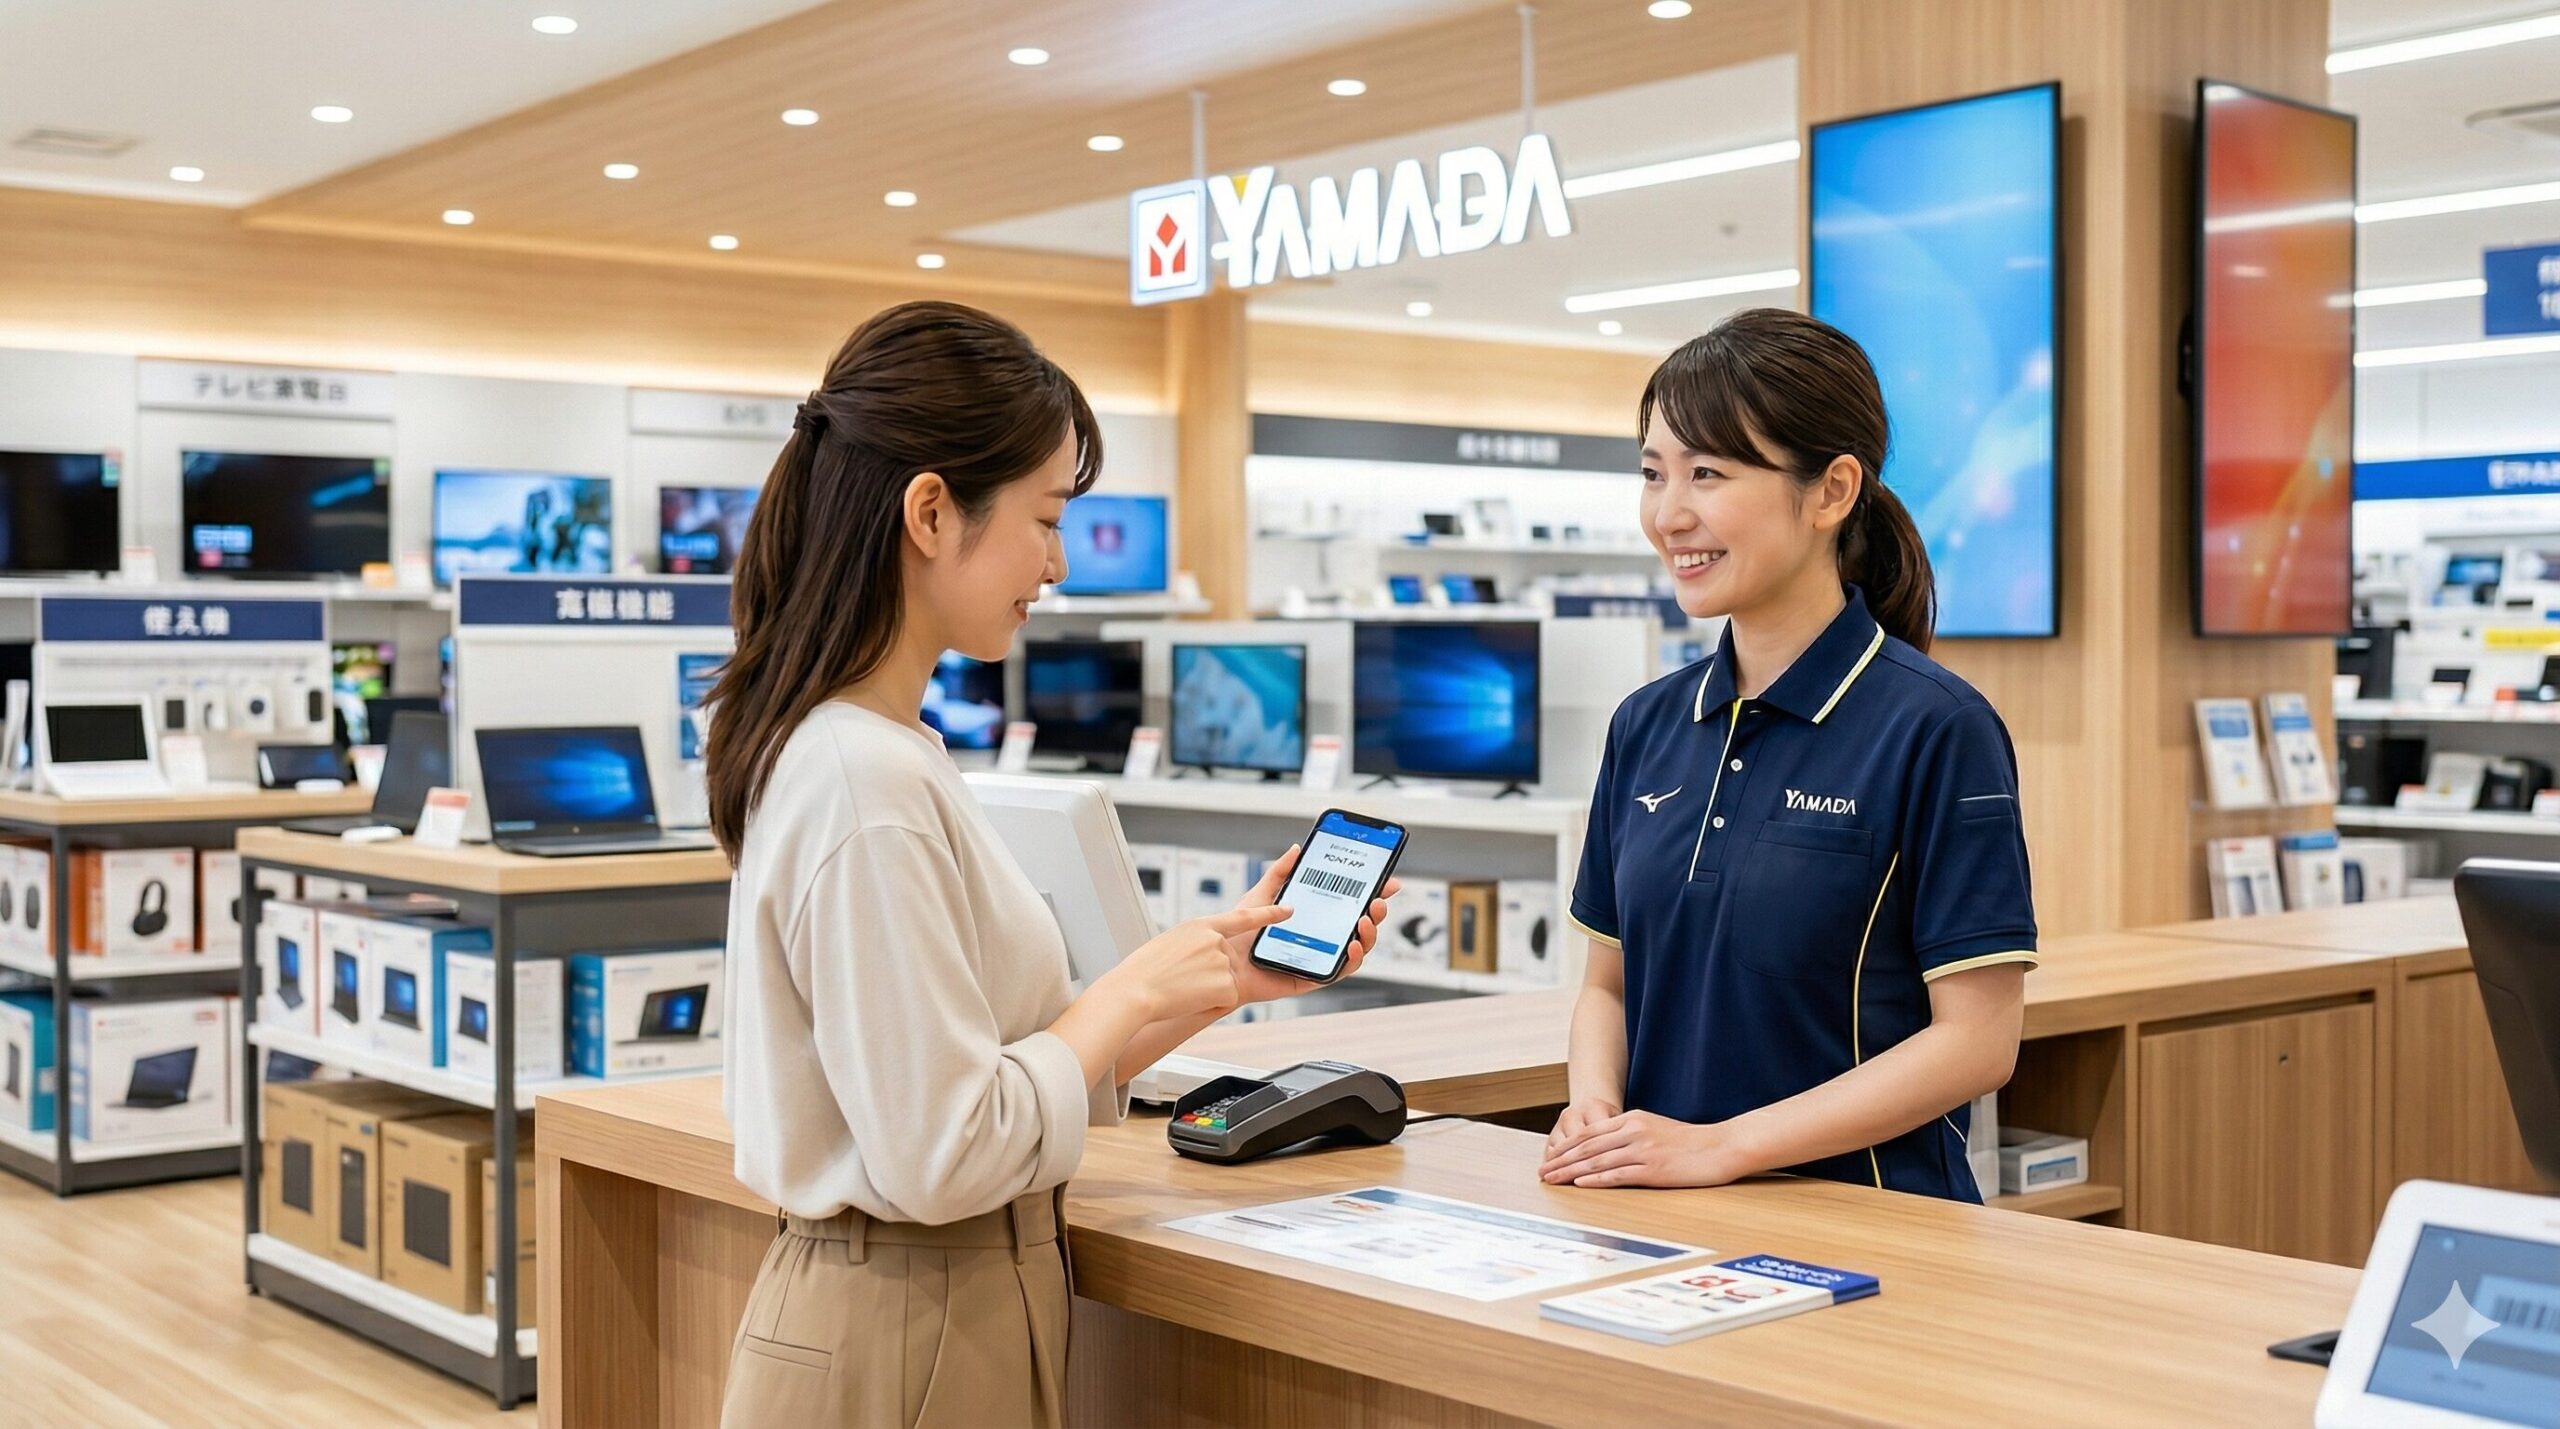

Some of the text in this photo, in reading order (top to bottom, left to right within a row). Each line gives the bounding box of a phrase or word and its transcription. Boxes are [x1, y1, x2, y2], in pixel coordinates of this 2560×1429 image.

[1207, 133, 1571, 288] YAMADA
[1785, 788, 1857, 816] YAMADA
[1347, 860, 1365, 869] APP
